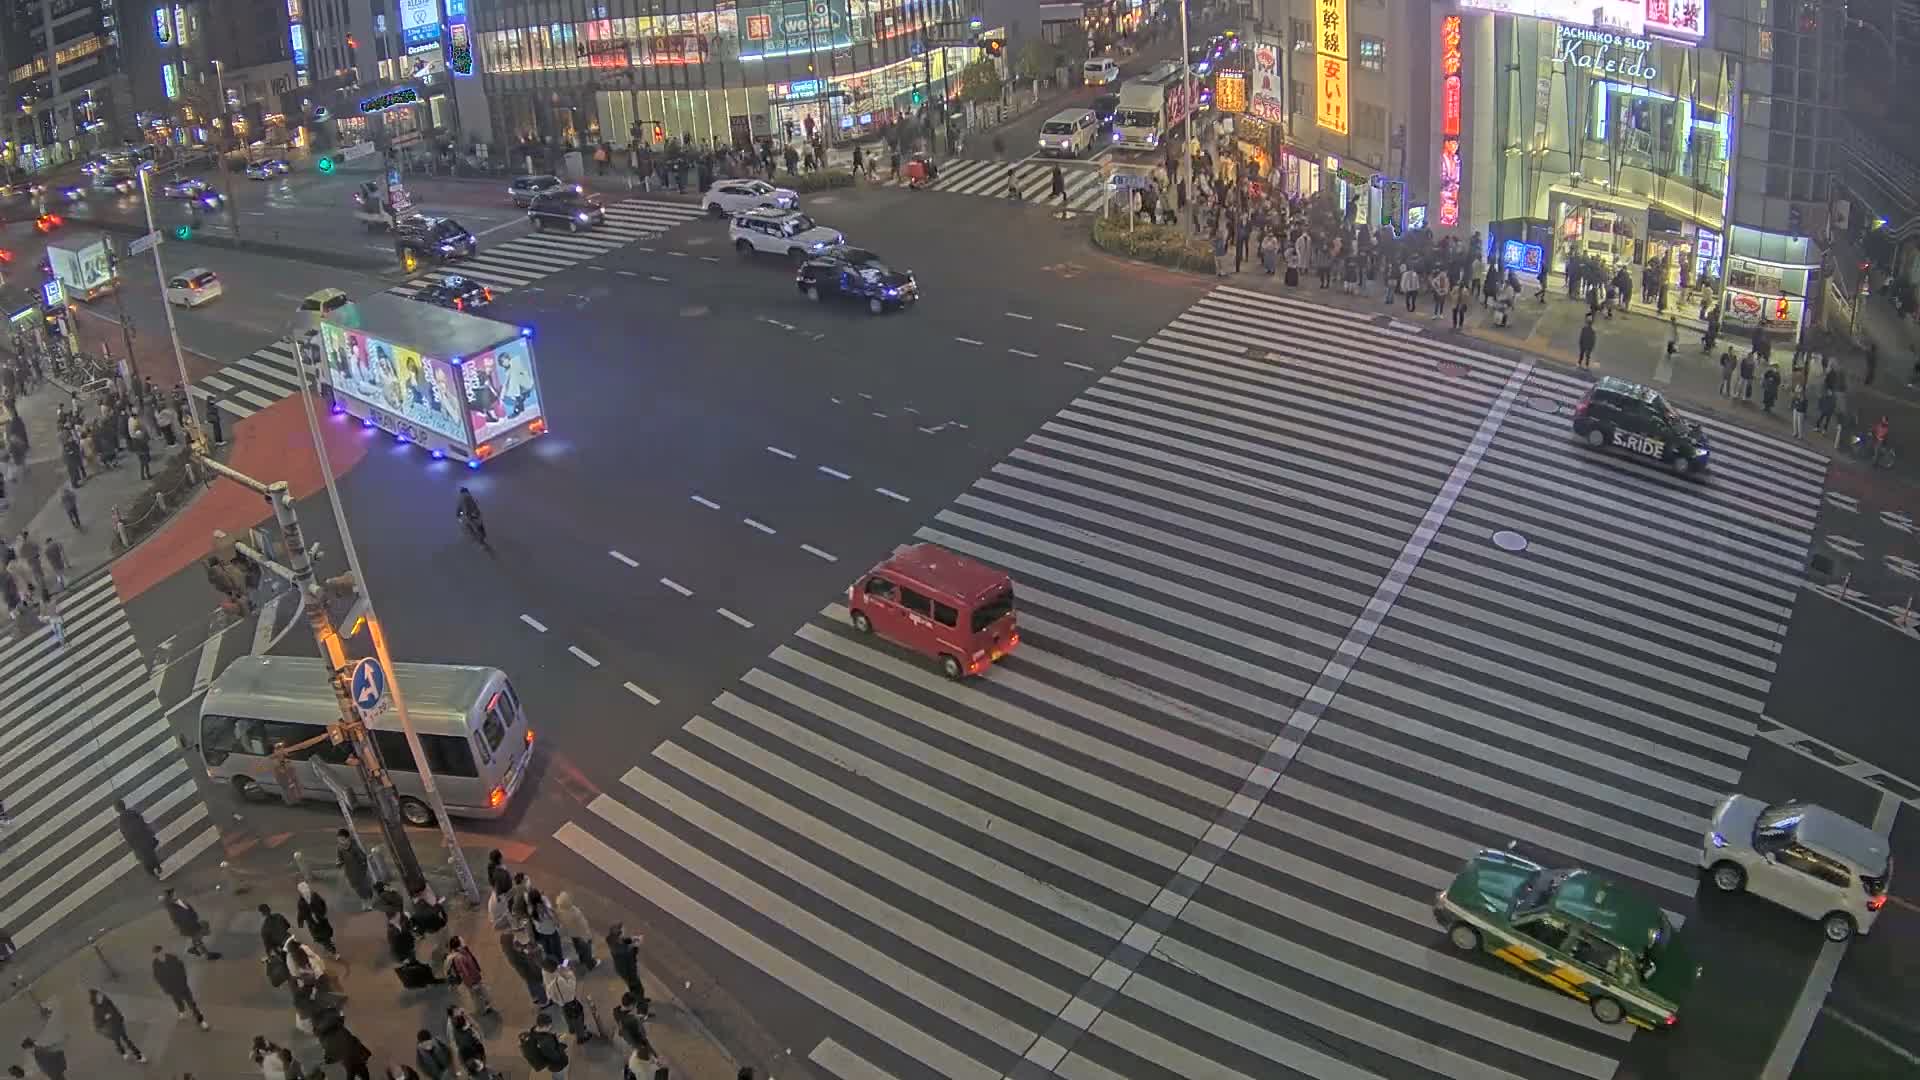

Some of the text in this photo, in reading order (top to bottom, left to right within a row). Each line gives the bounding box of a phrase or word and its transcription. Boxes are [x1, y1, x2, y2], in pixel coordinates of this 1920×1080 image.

[1557, 27, 1652, 51] PACHINKO & SLOT
[1552, 39, 1656, 80] Kaleido
[1612, 430, 1665, 459] S.RIDE
